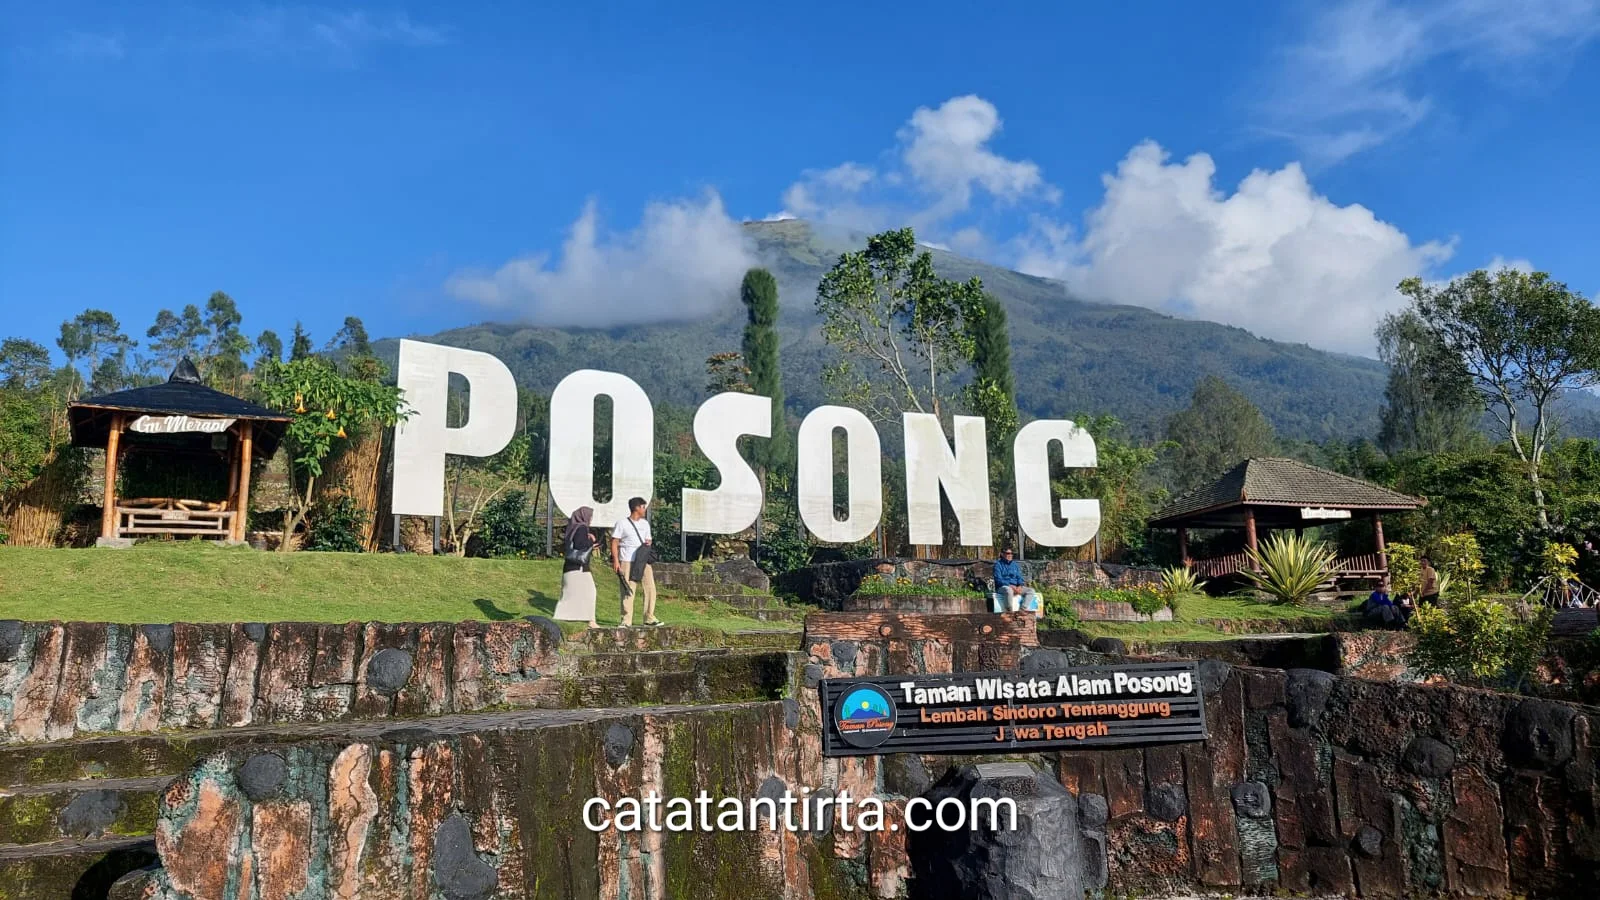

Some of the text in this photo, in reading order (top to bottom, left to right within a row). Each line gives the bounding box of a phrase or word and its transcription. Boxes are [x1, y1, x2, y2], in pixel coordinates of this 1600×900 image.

[391, 338, 1101, 547] POSONG
[900, 682, 972, 704] Taman
[1056, 675, 1112, 697] Alam
[1113, 672, 1193, 694] Posong
[920, 702, 1171, 723] Lembah Sindoro Temanggung
[995, 721, 1109, 741] Jwa Tengah
